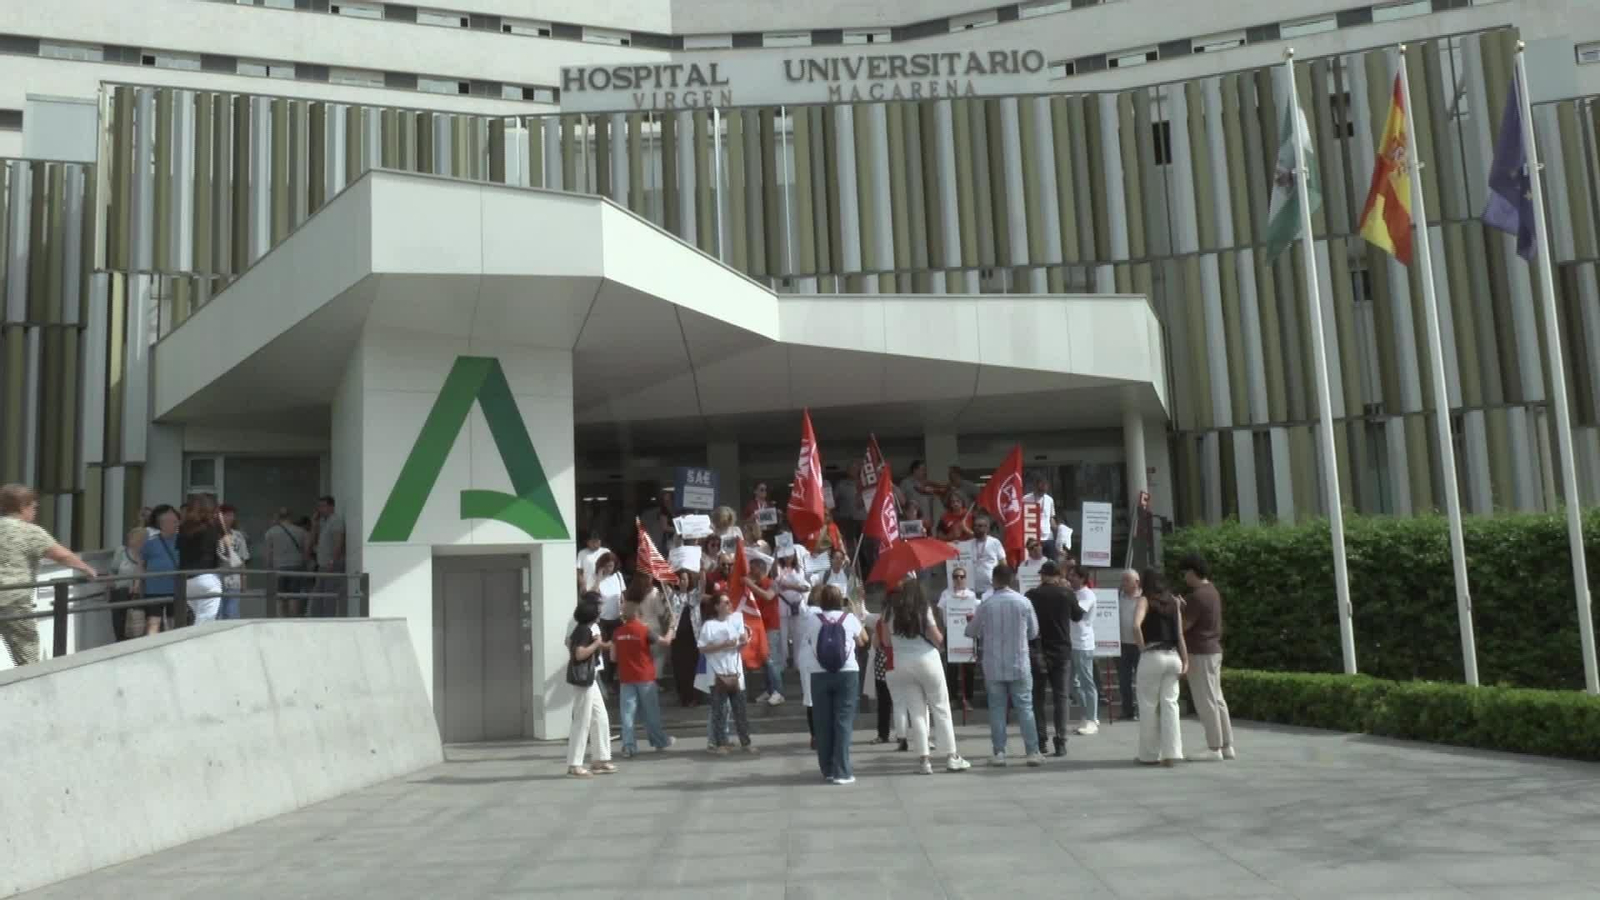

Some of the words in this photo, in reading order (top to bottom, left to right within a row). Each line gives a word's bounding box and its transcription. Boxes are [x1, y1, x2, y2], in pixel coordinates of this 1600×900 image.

[561, 63, 729, 92] HOSPITAL
[783, 50, 1046, 84] UNIVERSITARIO
[632, 89, 733, 109] VIRGEN
[828, 80, 978, 102] MACARENA
